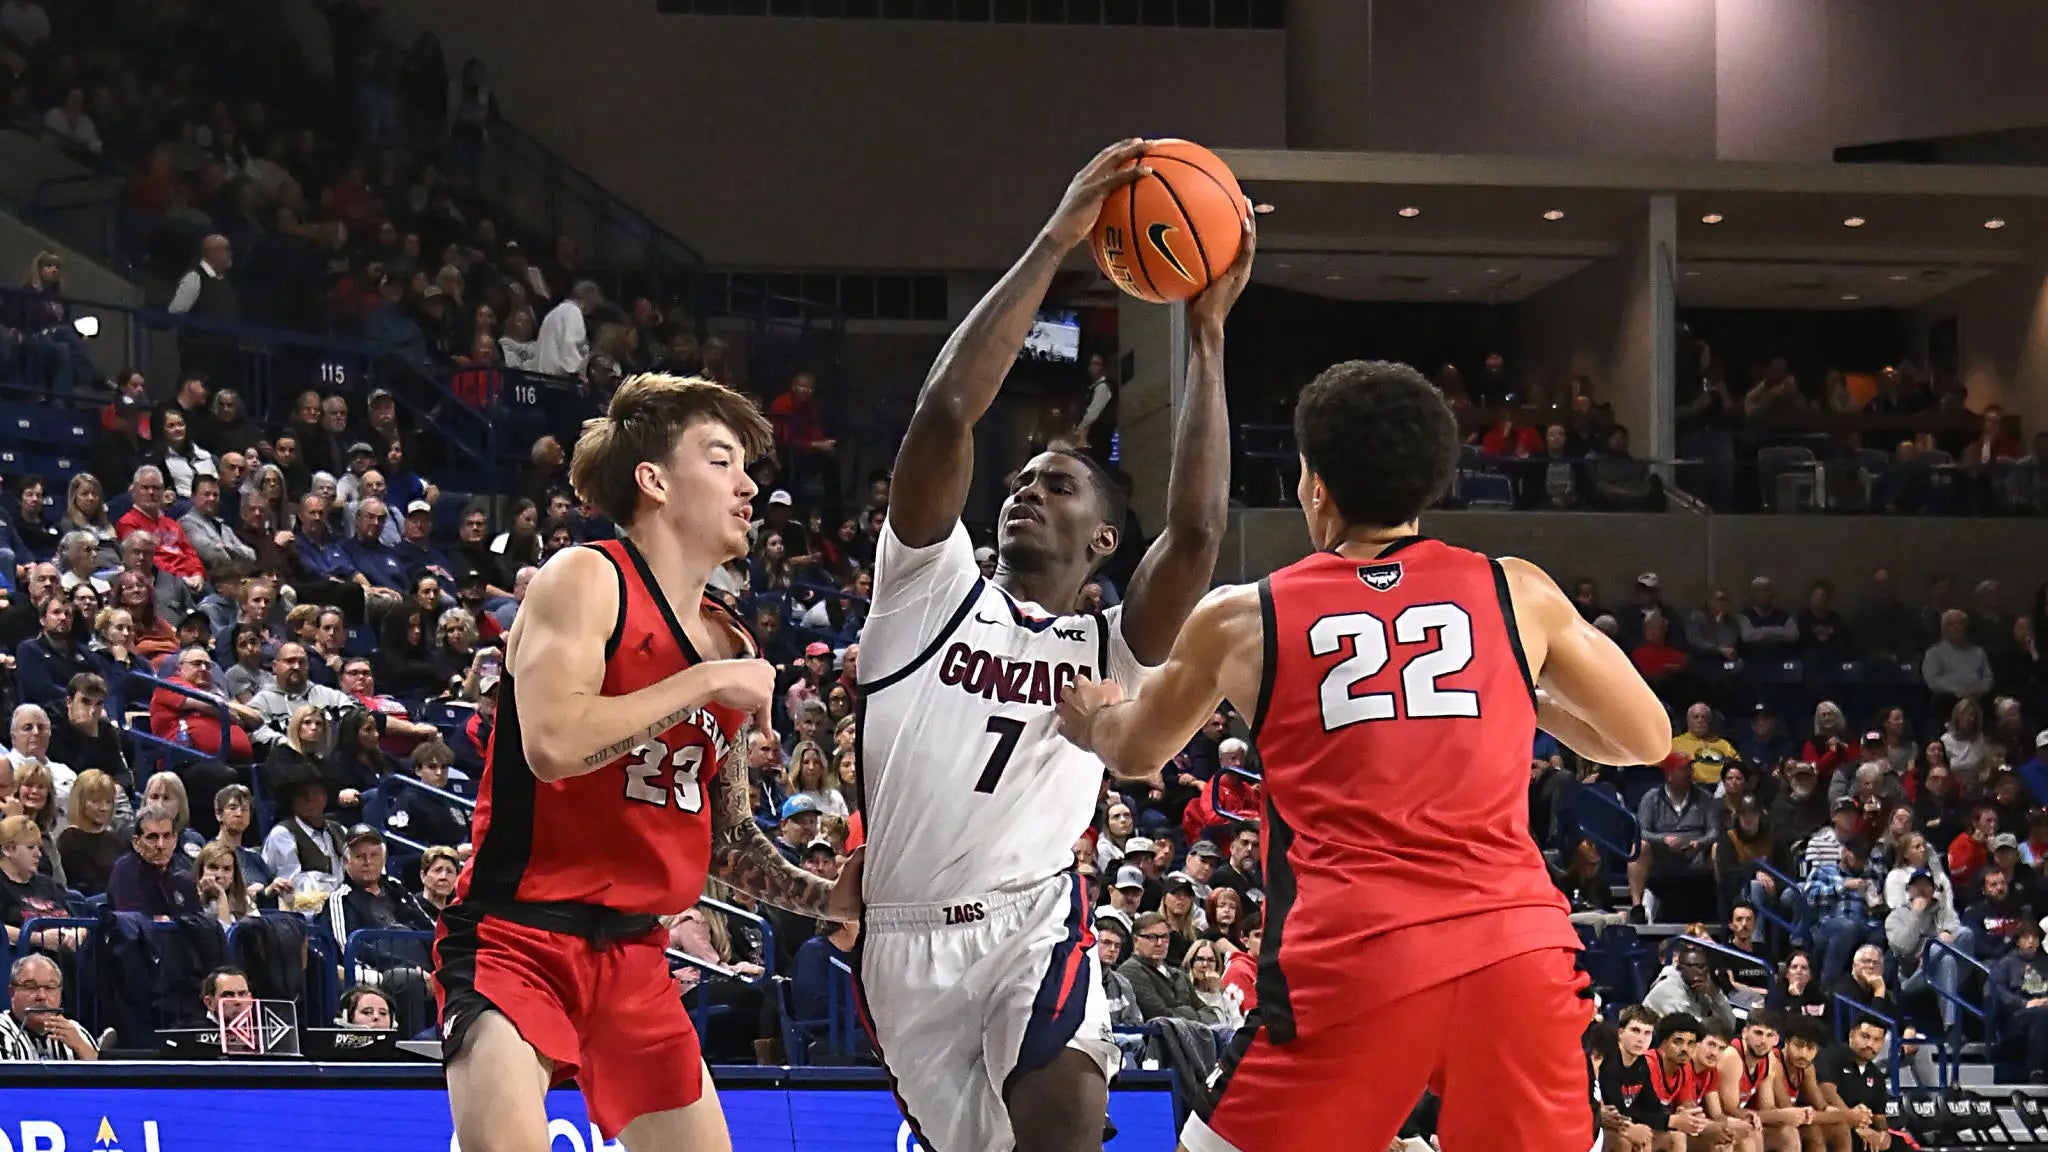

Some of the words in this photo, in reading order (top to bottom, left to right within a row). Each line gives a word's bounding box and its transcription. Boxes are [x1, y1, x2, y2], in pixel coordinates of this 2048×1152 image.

[321, 363, 345, 384] 115
[515, 385, 536, 404] 116
[1052, 627, 1086, 642] WCC
[1308, 601, 1481, 732] 22
[974, 715, 1027, 794] 7
[624, 737, 705, 814] 23
[942, 902, 985, 925] ZAGS
